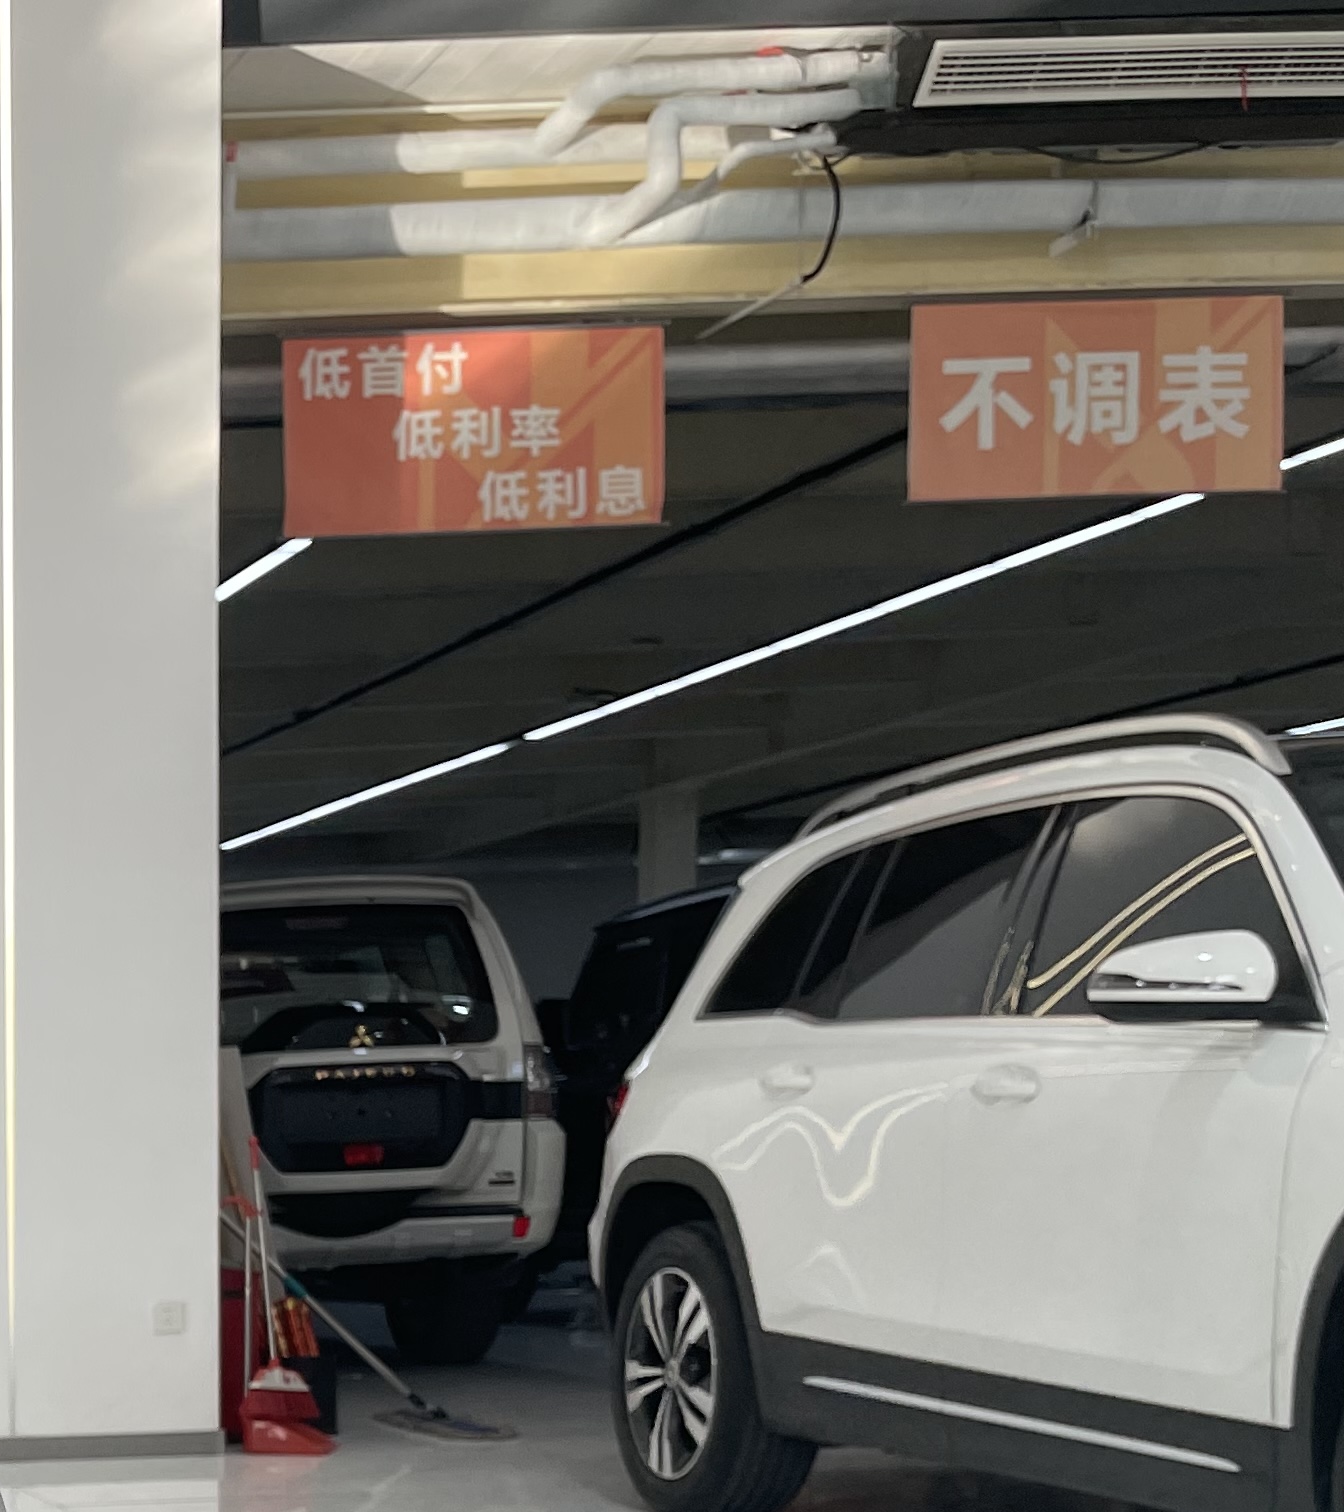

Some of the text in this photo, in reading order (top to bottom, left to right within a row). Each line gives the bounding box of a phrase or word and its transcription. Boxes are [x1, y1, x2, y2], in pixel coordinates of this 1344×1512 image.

[298, 341, 470, 401] 低首付
[938, 345, 1252, 451] 不调表
[392, 403, 562, 462] 低利率
[477, 464, 646, 523] 低利息
